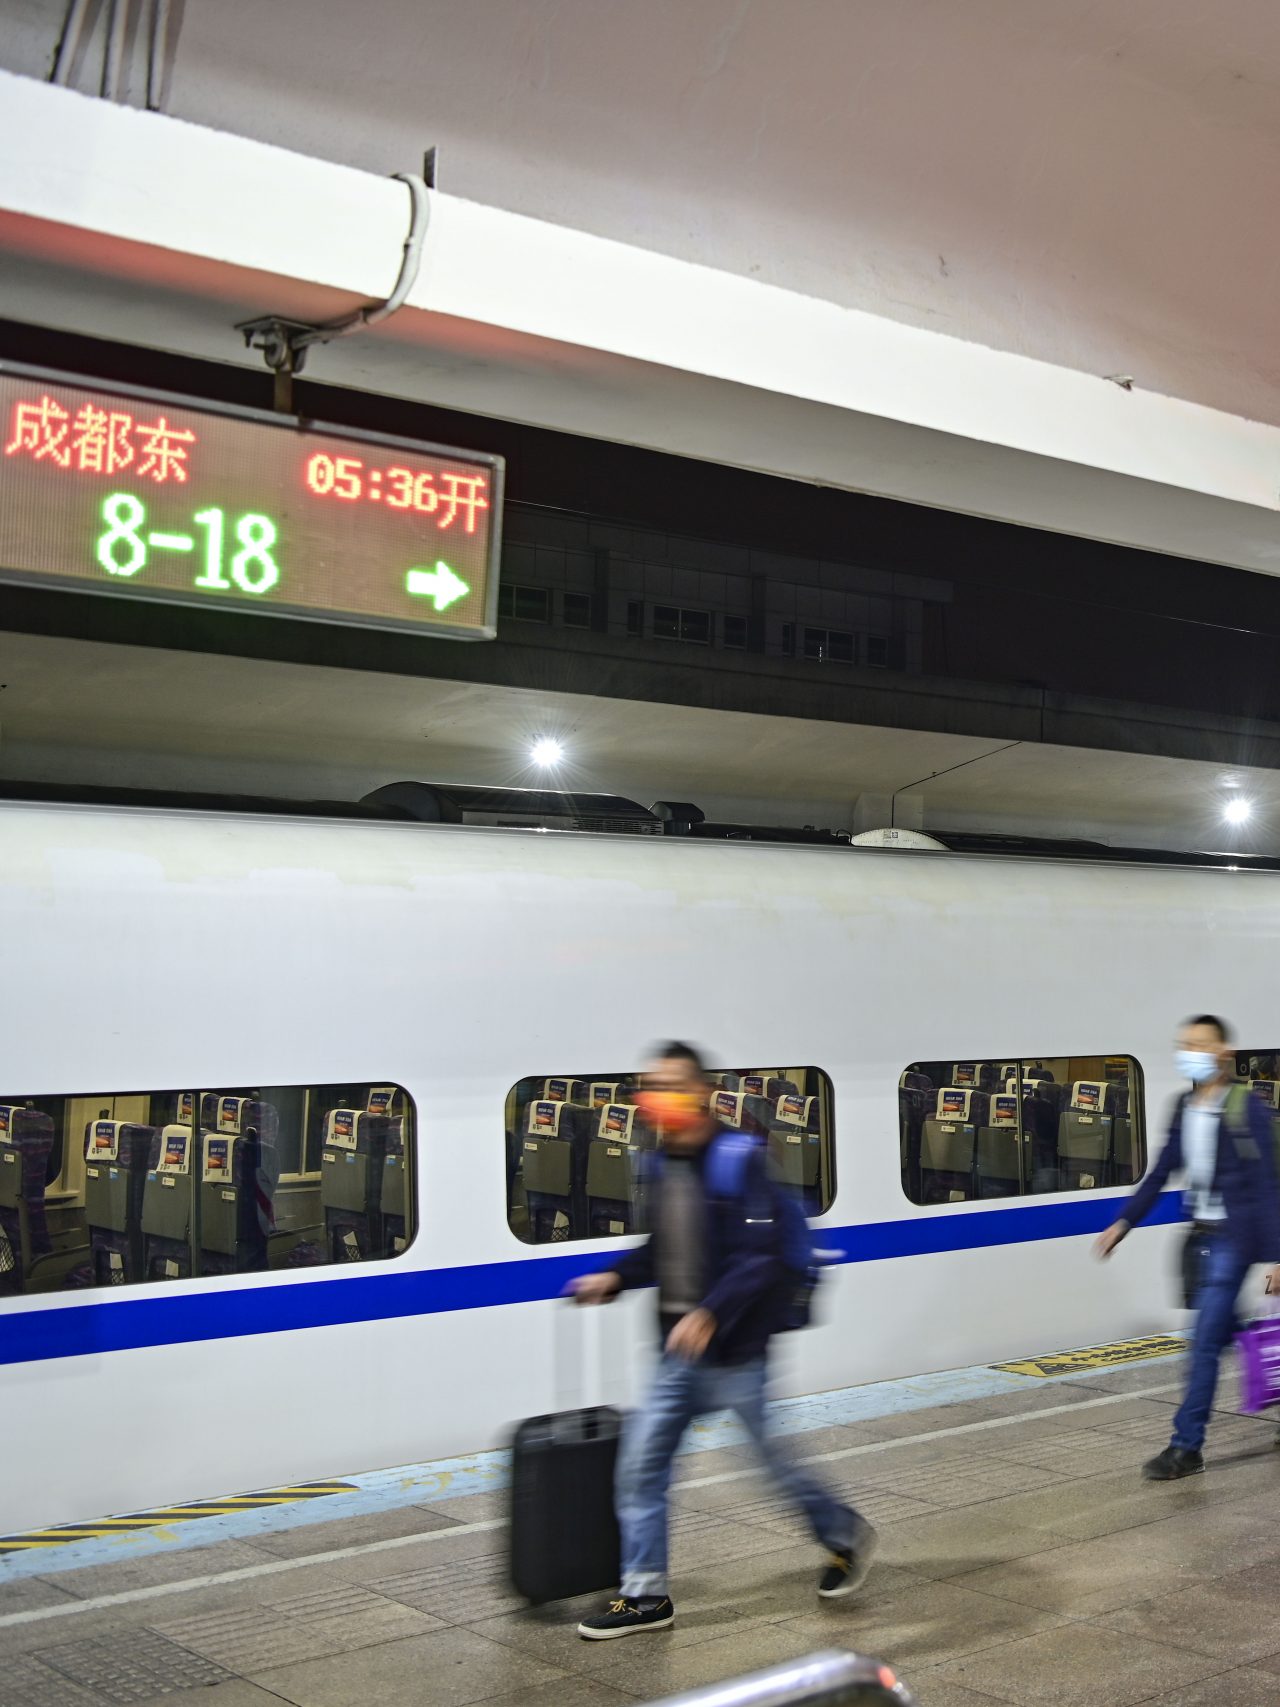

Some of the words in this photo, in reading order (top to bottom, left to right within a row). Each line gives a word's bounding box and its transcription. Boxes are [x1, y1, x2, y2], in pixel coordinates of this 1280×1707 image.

[5, 396, 197, 484] 成都东
[306, 453, 488, 532] 05:36开
[98, 492, 280, 594] 8-18
